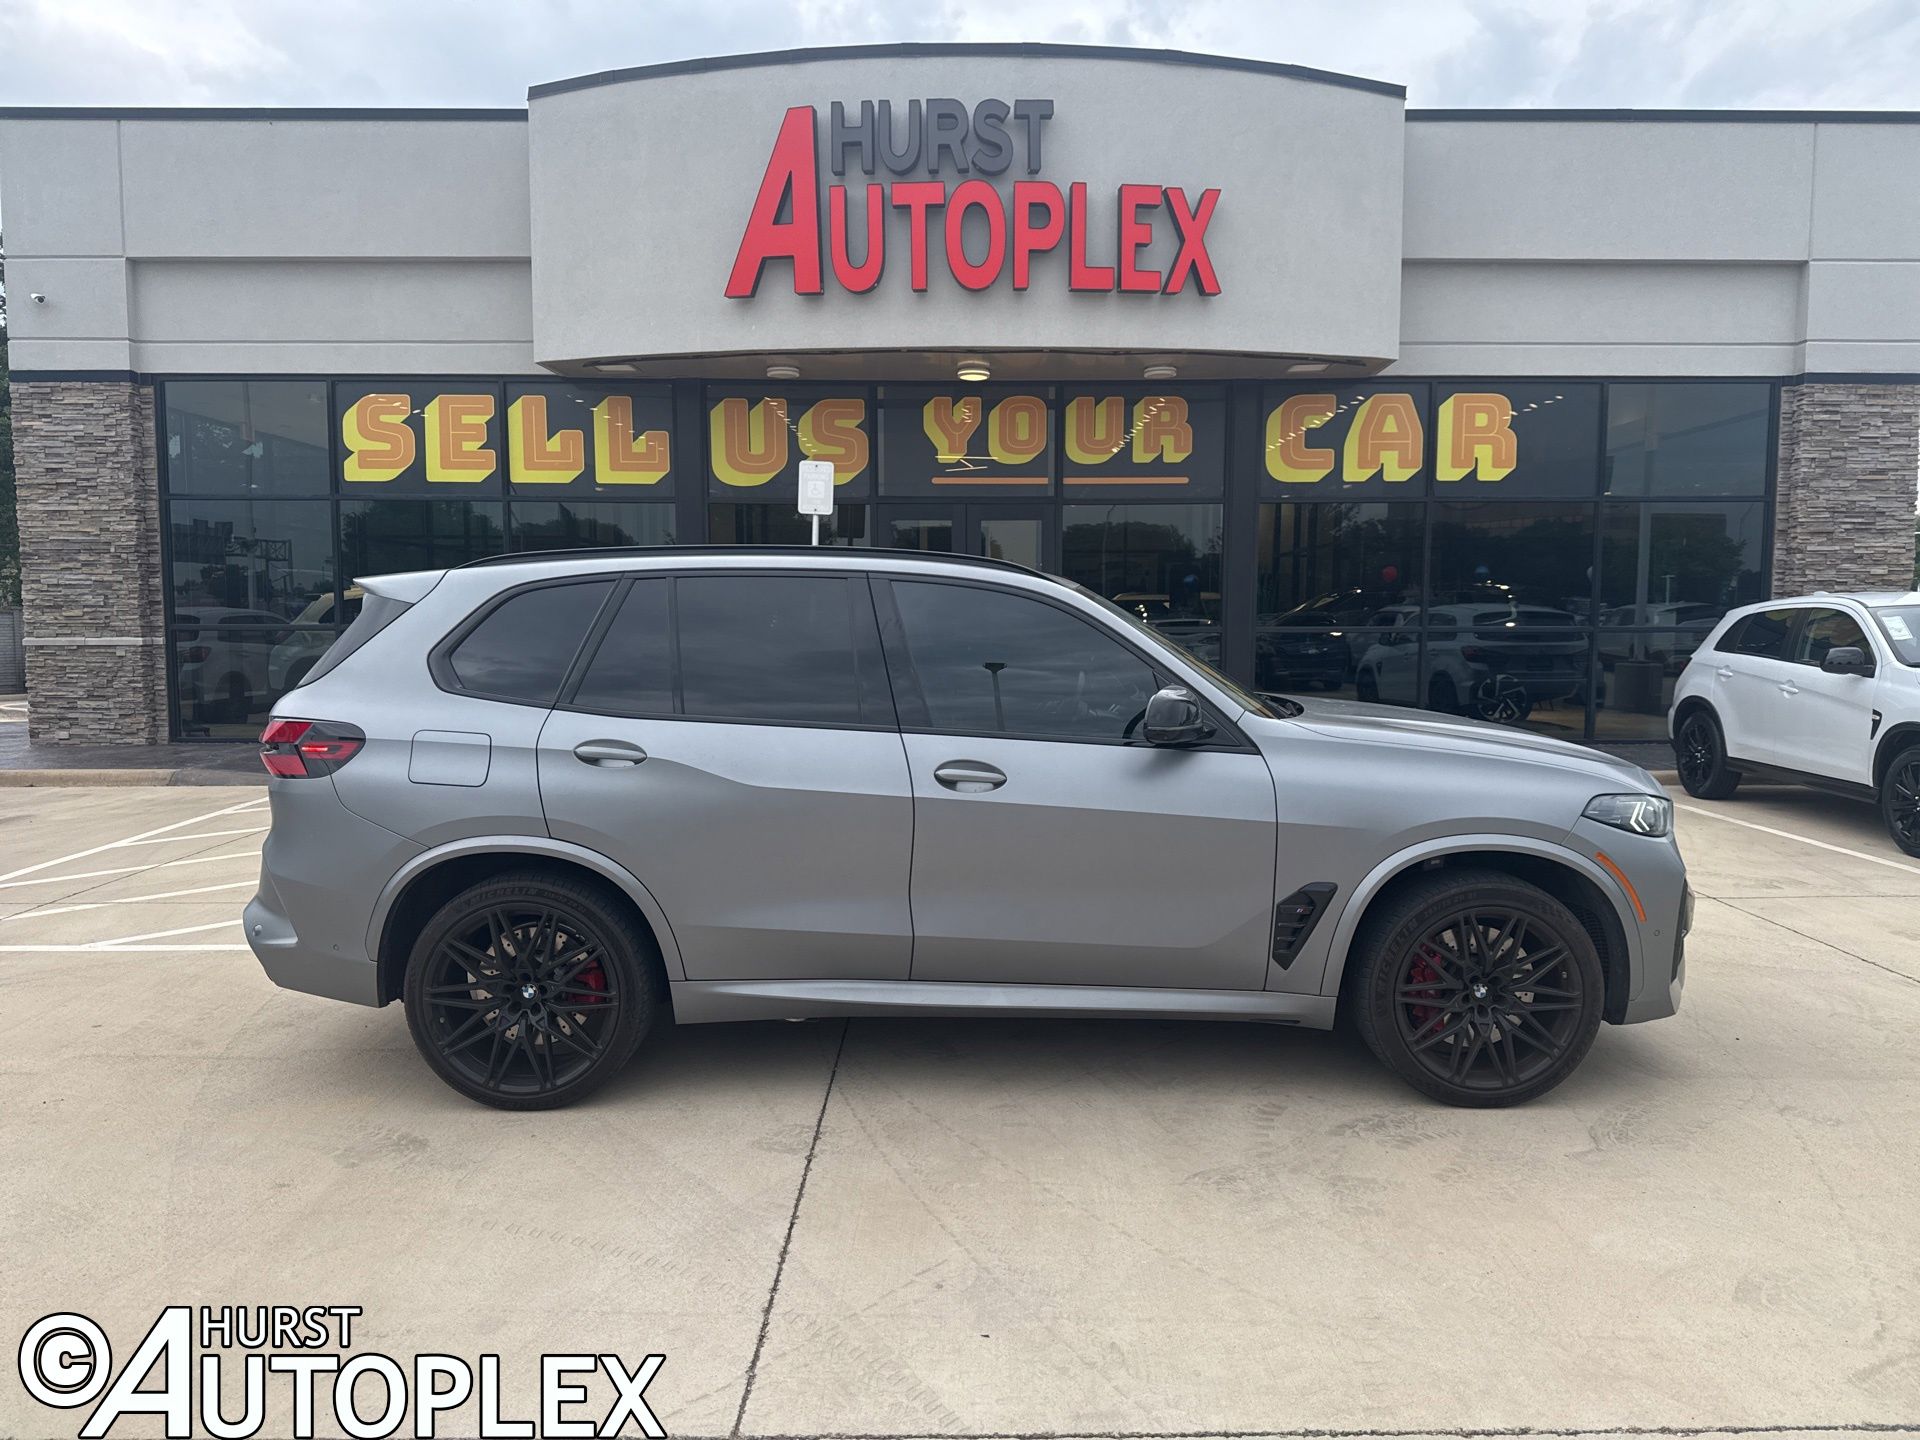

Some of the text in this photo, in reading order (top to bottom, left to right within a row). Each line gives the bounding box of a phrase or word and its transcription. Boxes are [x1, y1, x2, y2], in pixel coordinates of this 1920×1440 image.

[830, 98, 1054, 176] HURST
[724, 105, 1222, 300] AUTOPLEX
[342, 393, 1518, 487] SELL US YOUR CAR
